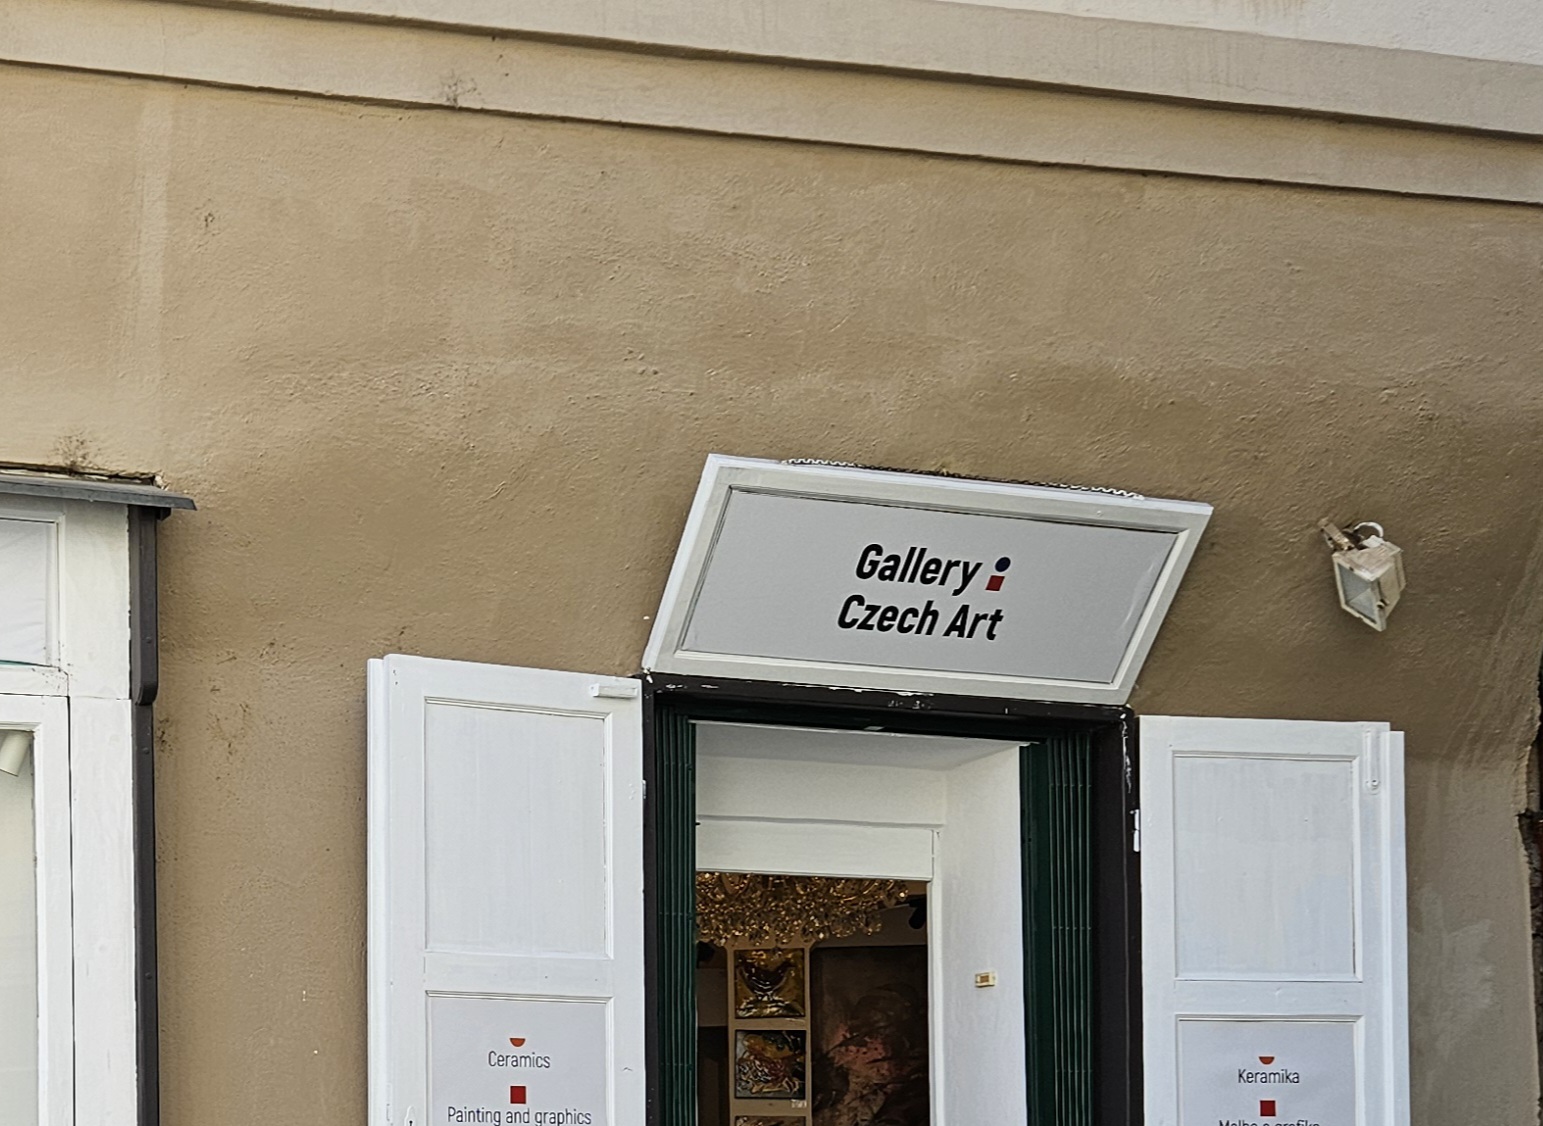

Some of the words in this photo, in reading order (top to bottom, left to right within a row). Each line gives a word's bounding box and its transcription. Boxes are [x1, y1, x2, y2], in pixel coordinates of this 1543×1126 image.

[855, 543, 984, 597] Gallery
[837, 594, 940, 636] Czech
[942, 604, 1004, 641] Art
[487, 1050, 551, 1069] Ceramics
[1237, 1068, 1300, 1084] Keramika
[505, 1106, 530, 1124] and
